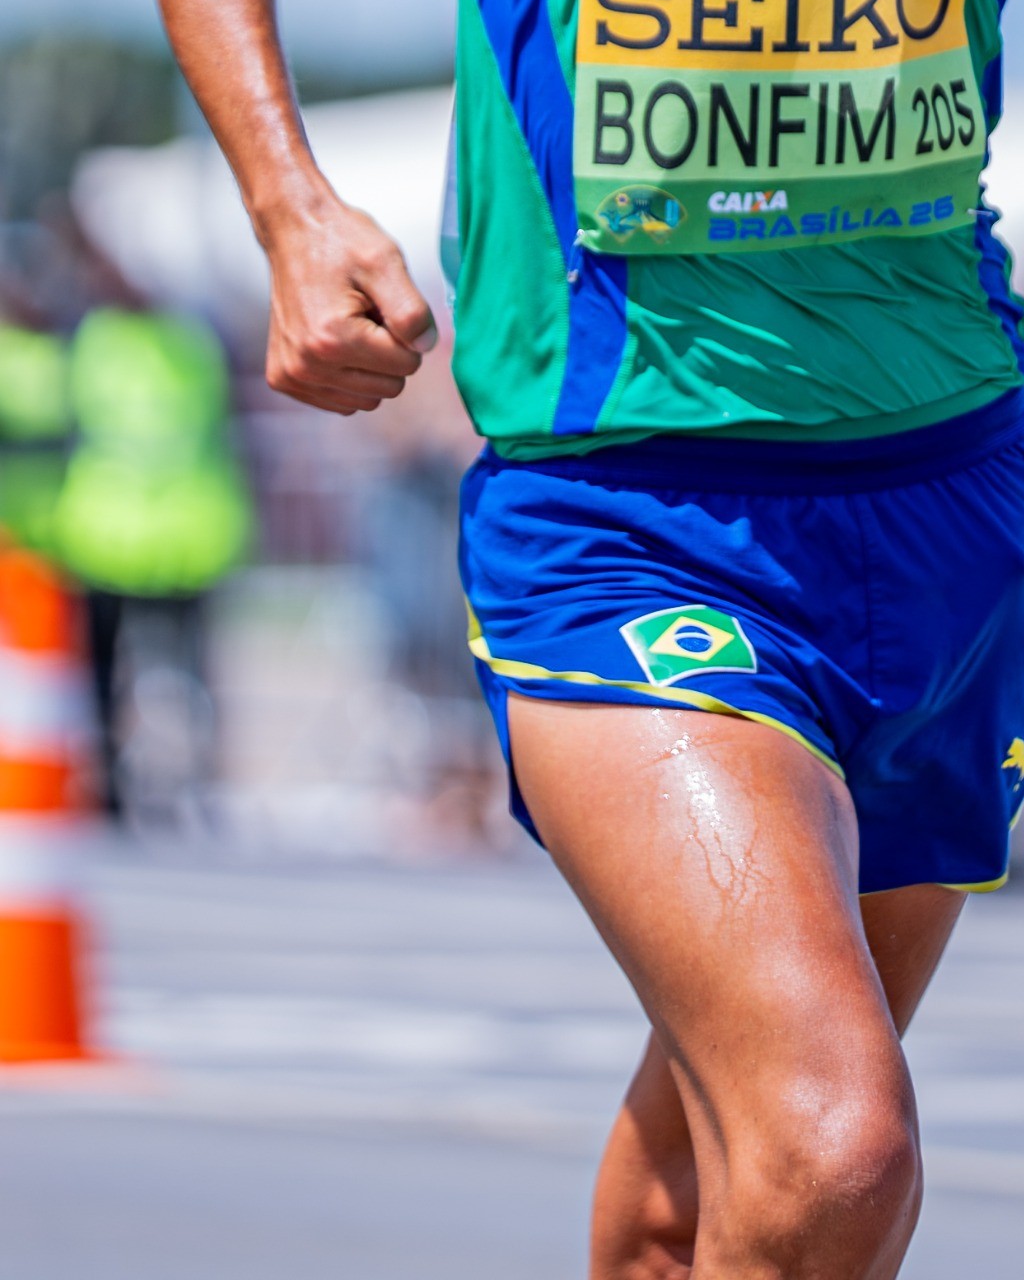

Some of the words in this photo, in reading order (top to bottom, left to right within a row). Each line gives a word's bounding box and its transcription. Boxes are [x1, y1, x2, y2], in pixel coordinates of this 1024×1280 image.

[593, 77, 896, 169] BONFIM
[912, 79, 976, 155] 205
[707, 206, 901, 241] BRASÍLIA
[908, 195, 955, 226] 26
[708, 189, 788, 213] CAIXA
